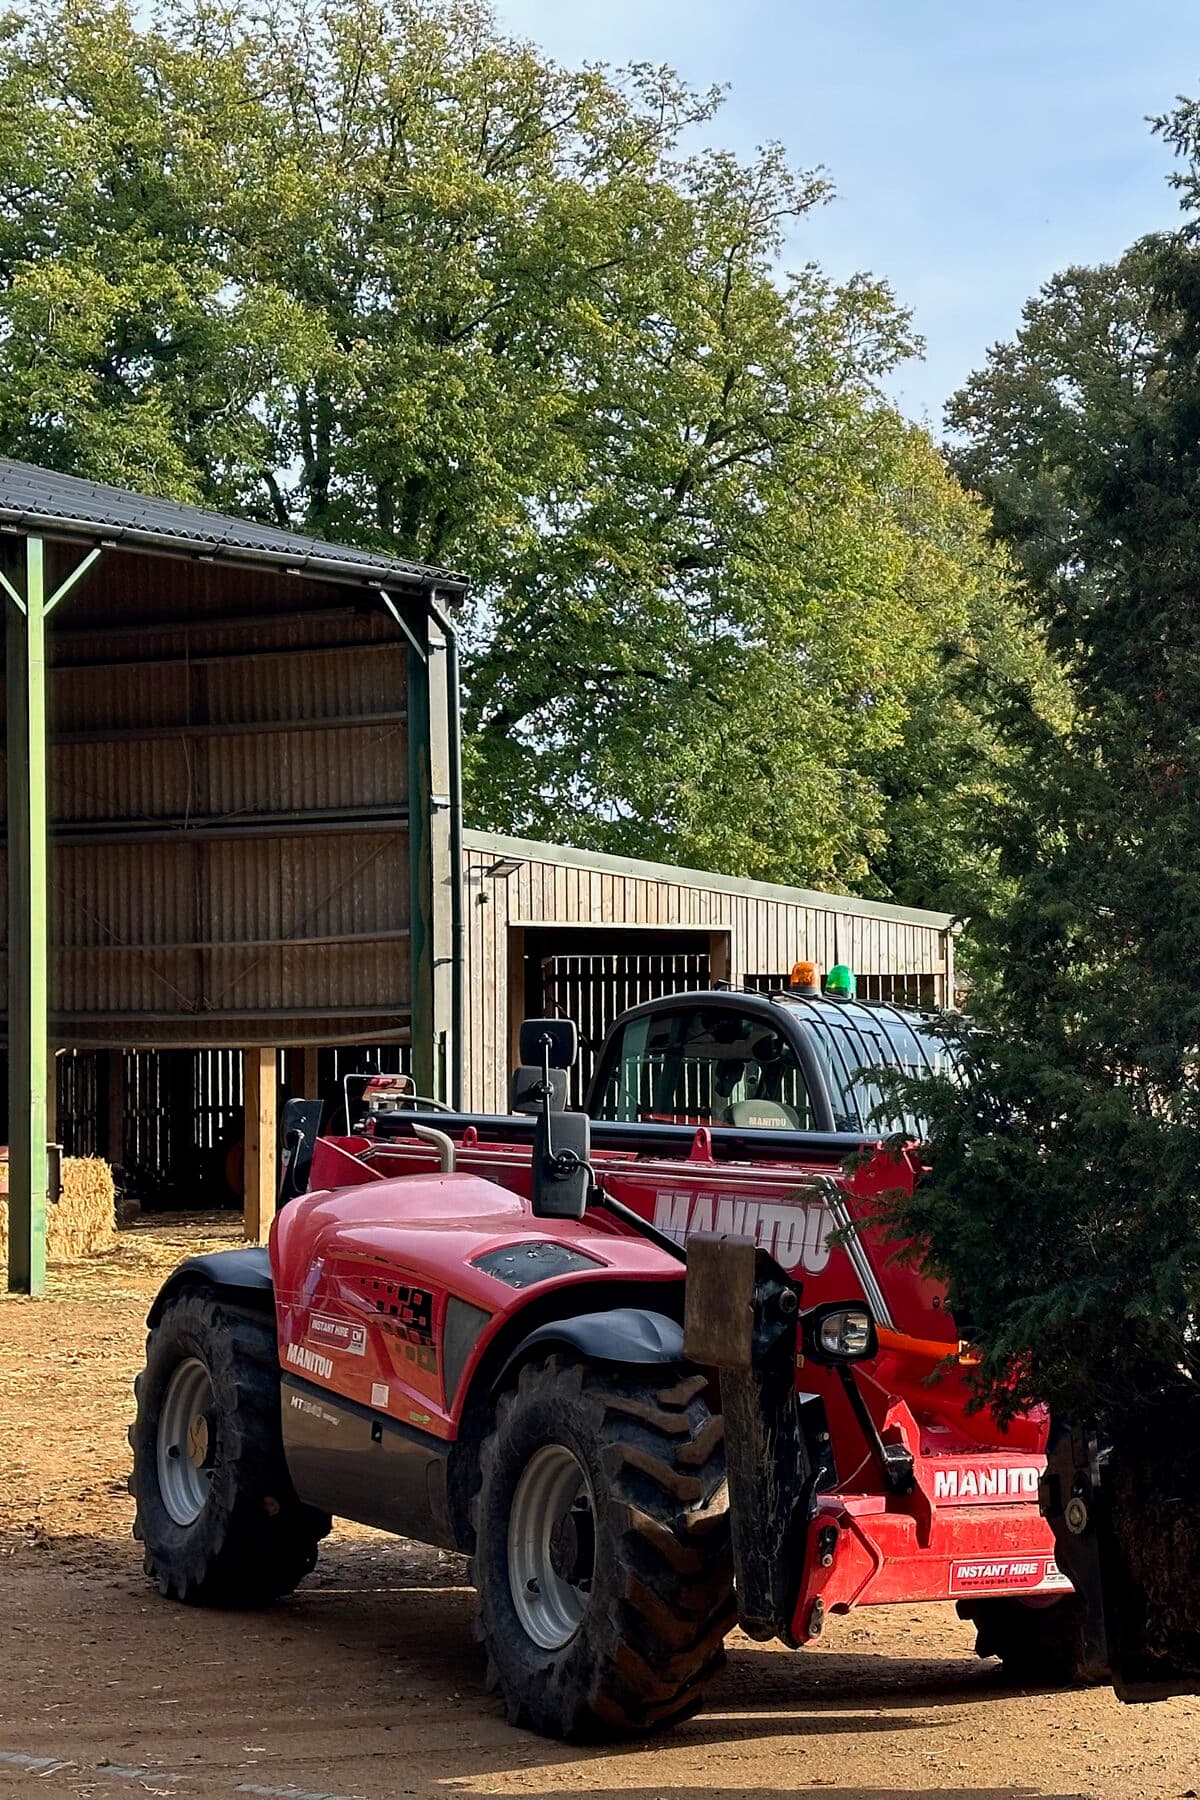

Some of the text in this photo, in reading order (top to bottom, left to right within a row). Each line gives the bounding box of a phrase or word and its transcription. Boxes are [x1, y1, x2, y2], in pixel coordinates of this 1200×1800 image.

[749, 1116, 786, 1127] MANITOU
[312, 1319, 335, 1334] INSTANT
[287, 1342, 333, 1379] MANITOU
[934, 1466, 1047, 1498] MANITO
[957, 1564, 1008, 1578] INSTANT
[1009, 1562, 1038, 1575] HIRE
